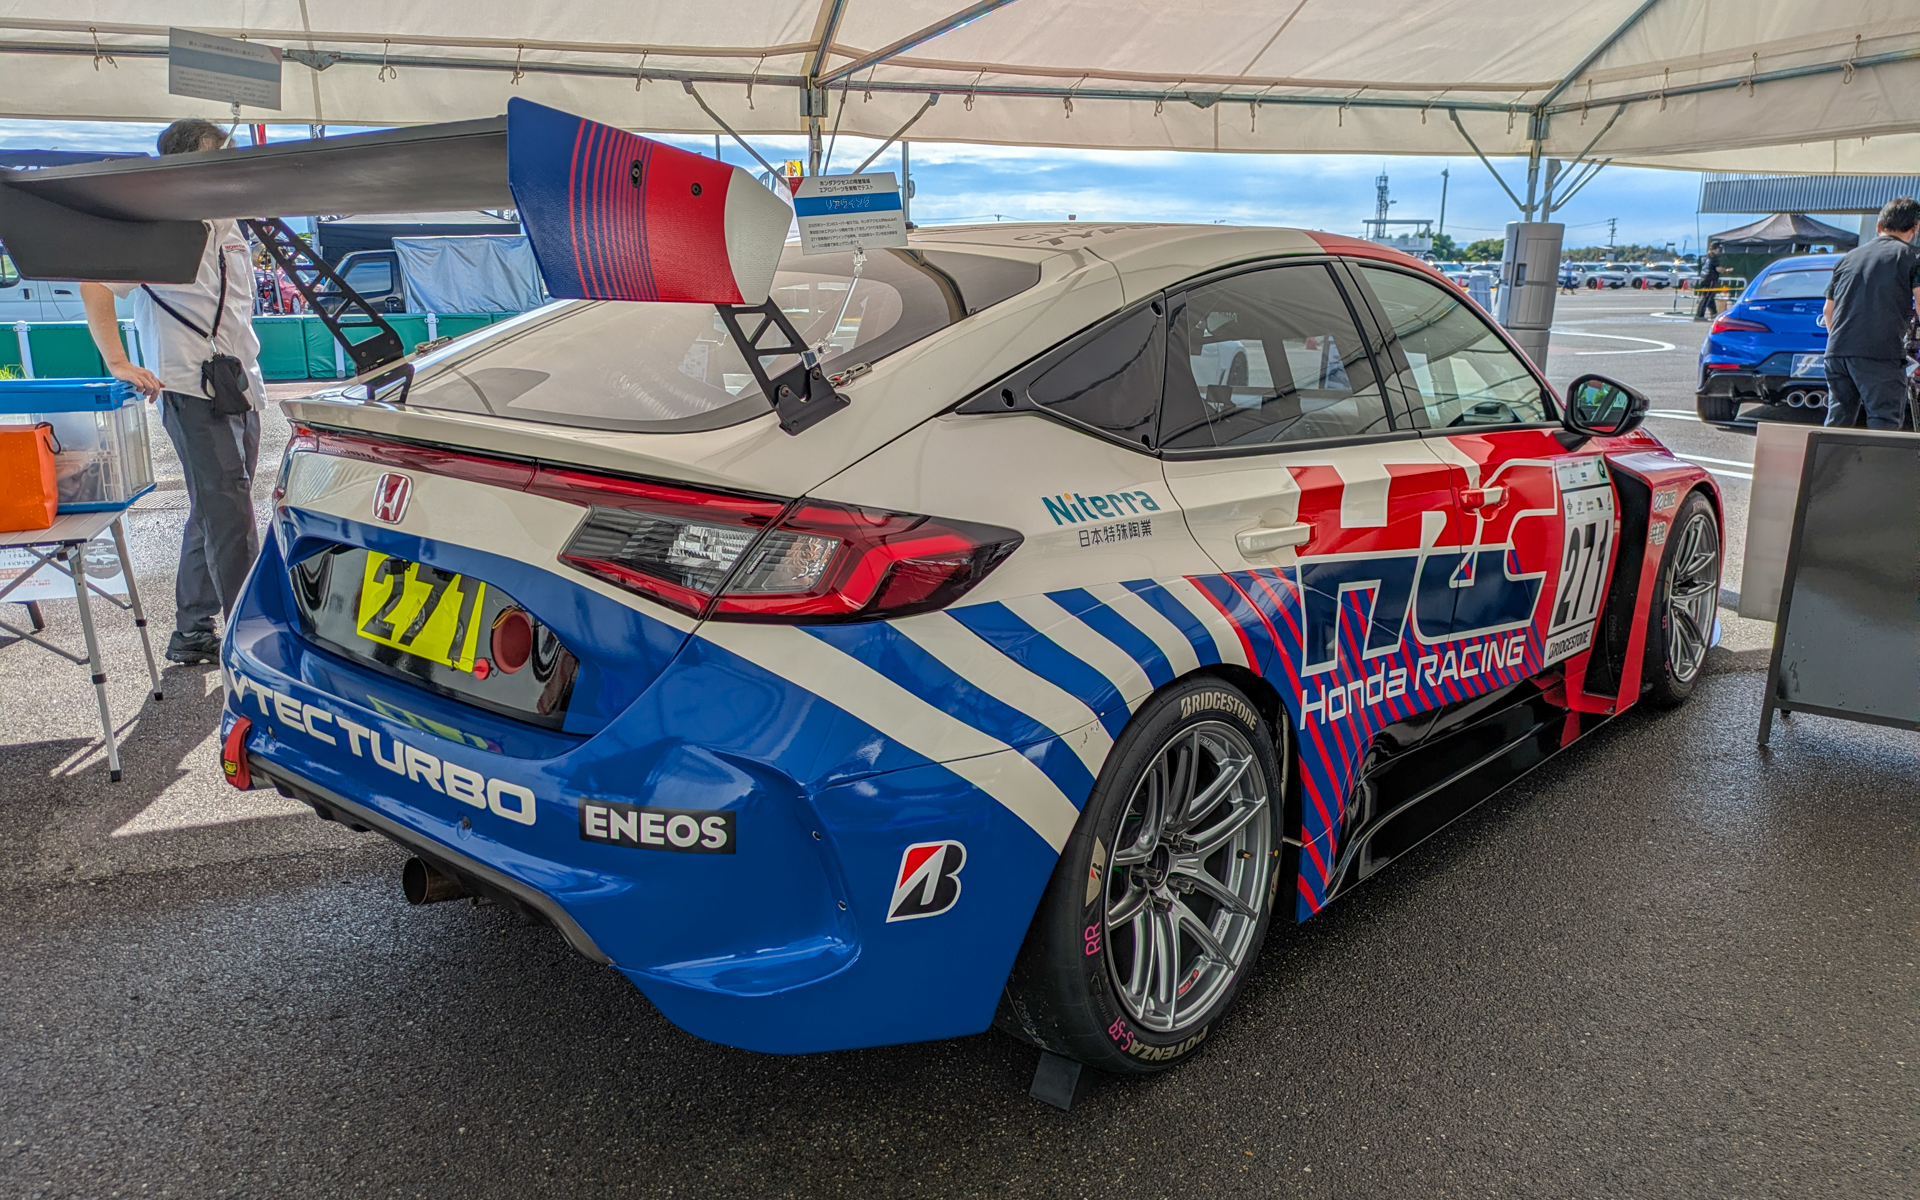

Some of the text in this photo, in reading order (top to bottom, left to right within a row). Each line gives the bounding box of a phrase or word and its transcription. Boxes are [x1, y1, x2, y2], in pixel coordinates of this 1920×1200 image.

[825, 196, 871, 210] リアウイング
[1041, 490, 1161, 526] Niterra
[1078, 519, 1152, 548] 日本特殊陶業
[1552, 519, 1609, 629] 271
[361, 556, 482, 662] 271
[1548, 629, 1590, 661] BRIDGESTONE
[1300, 634, 1527, 731] Honda RACING
[1180, 691, 1258, 731] BRIDGESTONE
[228, 672, 537, 827] VTEC TURBO
[585, 804, 728, 849] ENEOS
[1128, 1025, 1209, 1062] POTENZA
